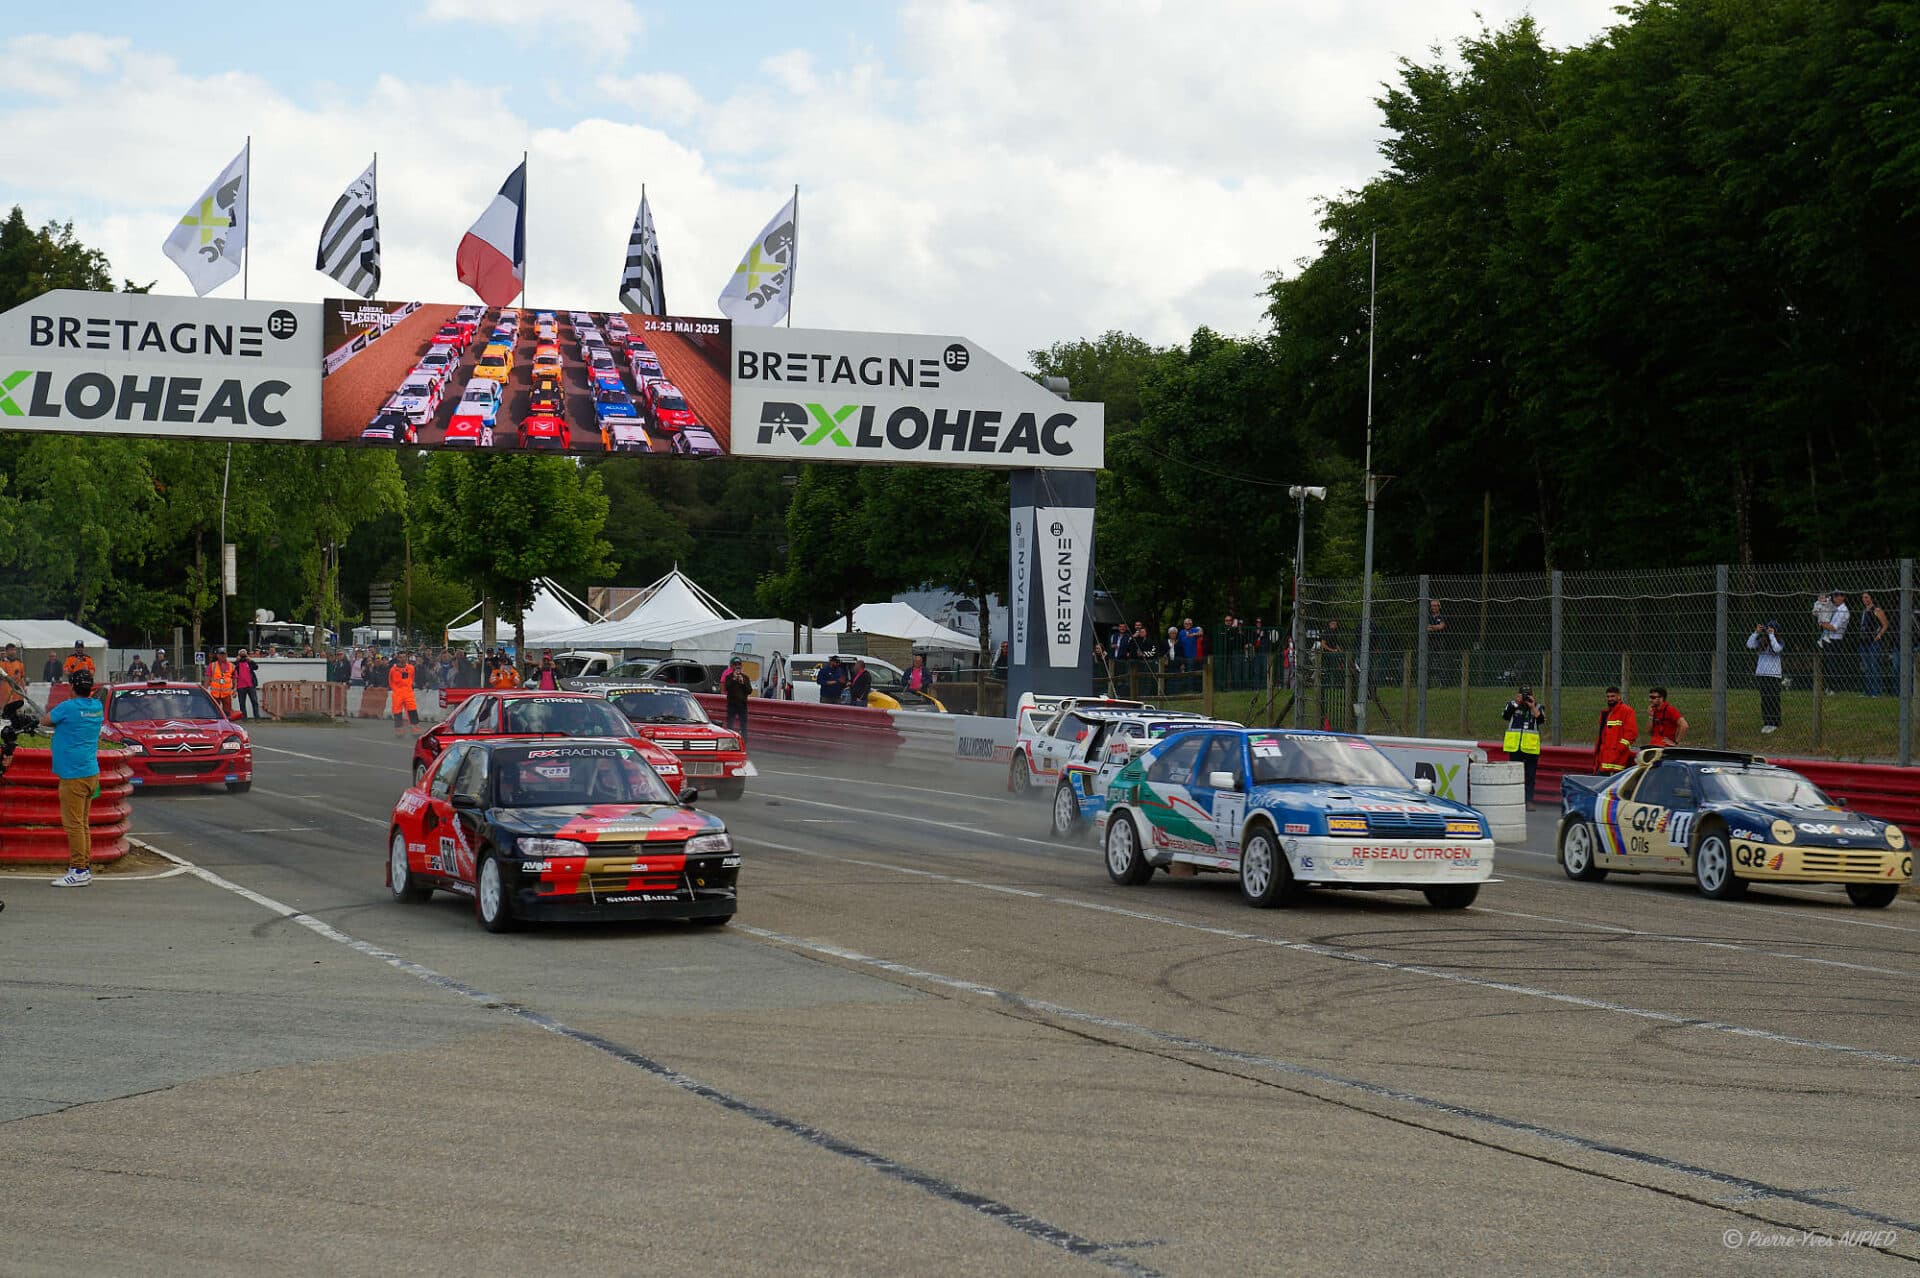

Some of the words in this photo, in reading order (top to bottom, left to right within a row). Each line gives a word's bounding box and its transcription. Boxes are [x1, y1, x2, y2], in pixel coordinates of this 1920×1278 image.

[644, 321, 672, 332] 24-25
[675, 322, 693, 333] MAI
[695, 323, 720, 334] 2025
[30, 315, 263, 358] BRETAGNE
[738, 350, 940, 388] BRETAGNE
[1058, 537, 1072, 645] BRETAGNE
[561, 749, 616, 757] RACING
[1358, 803, 1438, 813] TOTAL
[1632, 806, 1660, 833] Q8
[1286, 825, 1309, 833] TOTAL
[1798, 823, 1832, 834] Q8
[1631, 837, 1650, 853] Oils
[1352, 847, 1409, 859] RESEAU
[1736, 844, 1766, 868] Q8
[522, 862, 552, 870] AVON
[606, 895, 641, 903] SIMON
